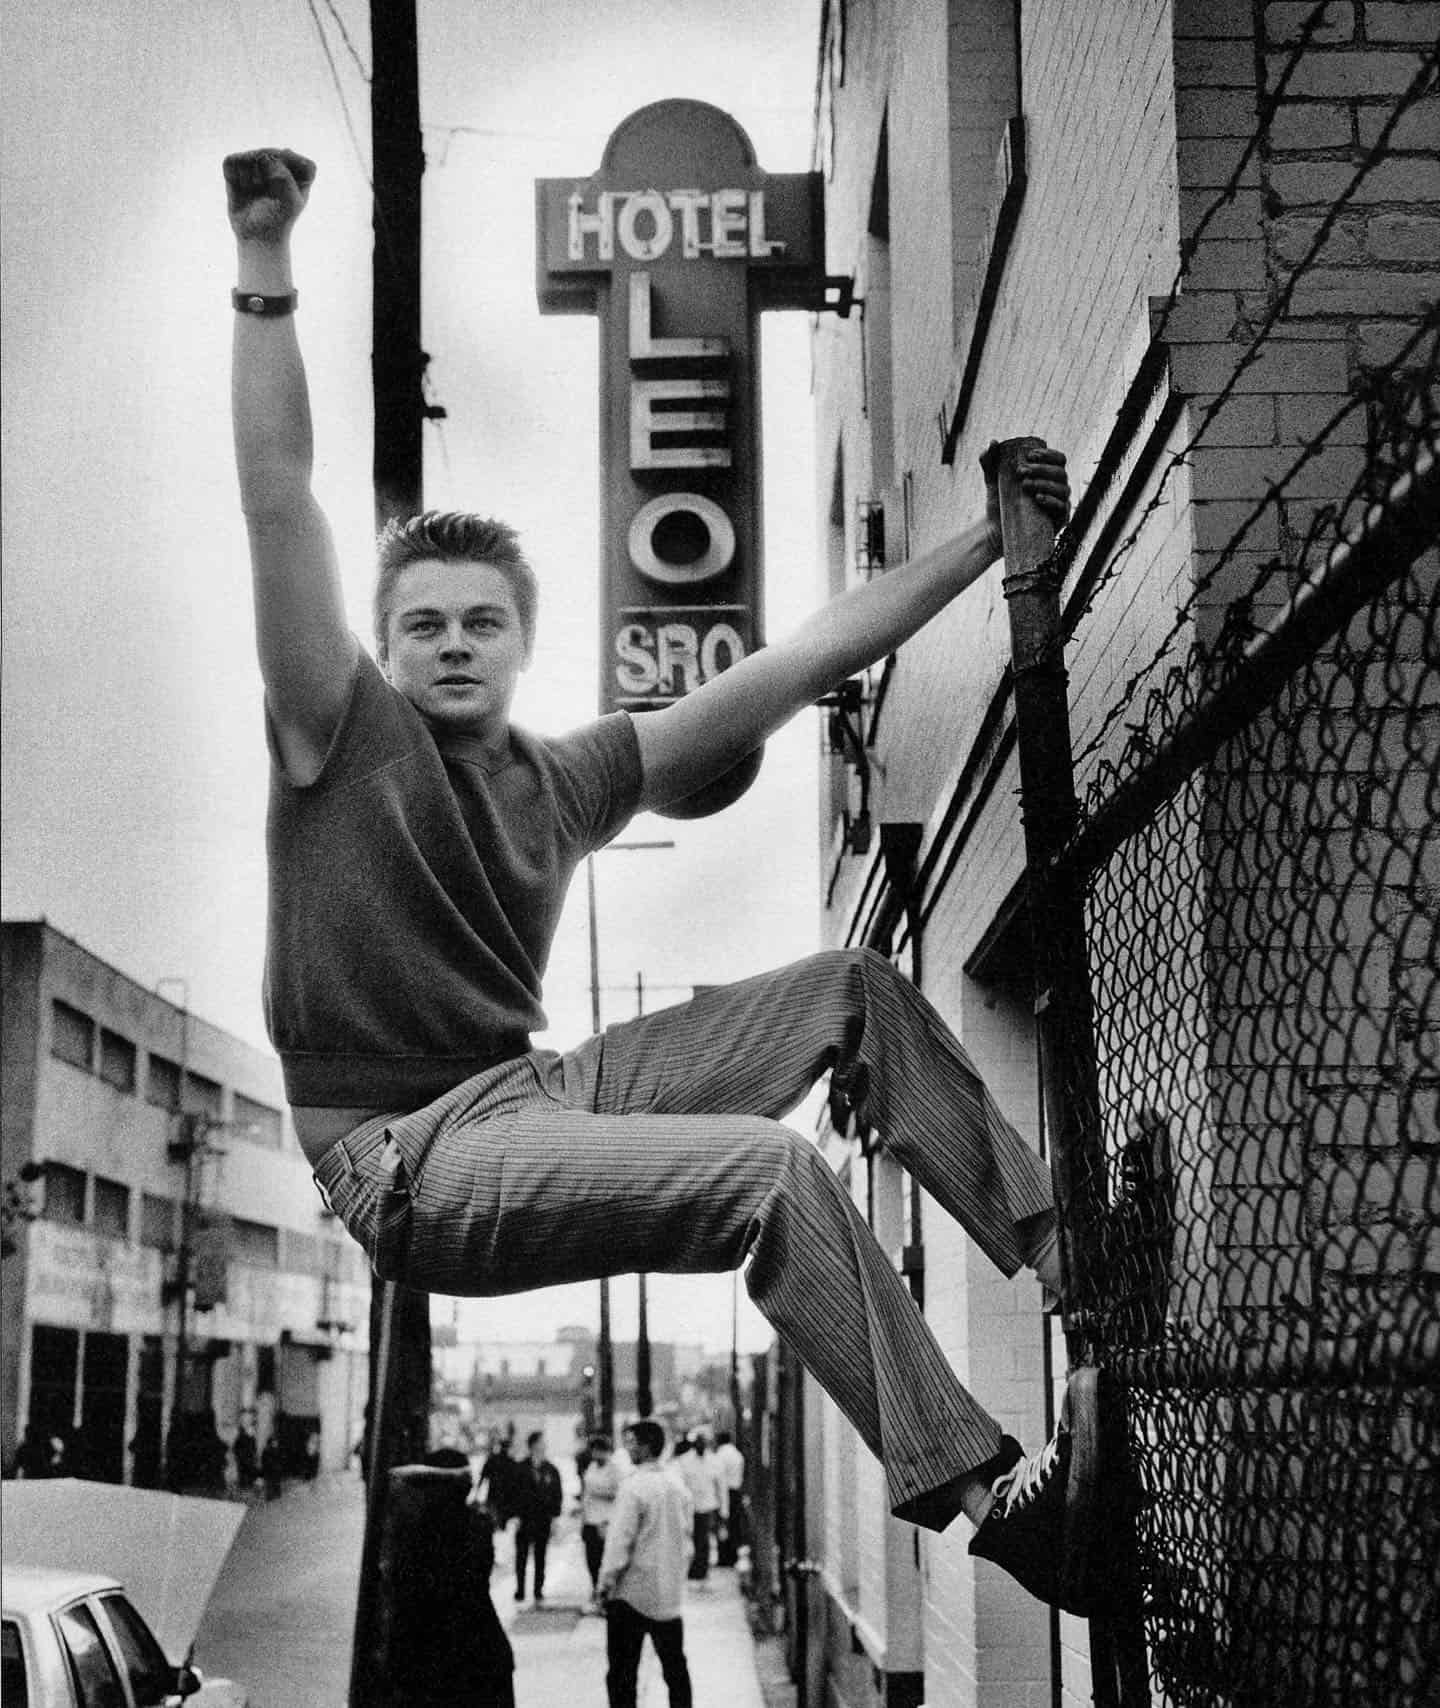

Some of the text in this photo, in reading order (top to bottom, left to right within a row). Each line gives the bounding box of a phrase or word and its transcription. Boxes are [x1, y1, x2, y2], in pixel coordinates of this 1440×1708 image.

[568, 188, 786, 261] HOTEL
[628, 271, 735, 583] LEO
[616, 624, 745, 695] SRO
